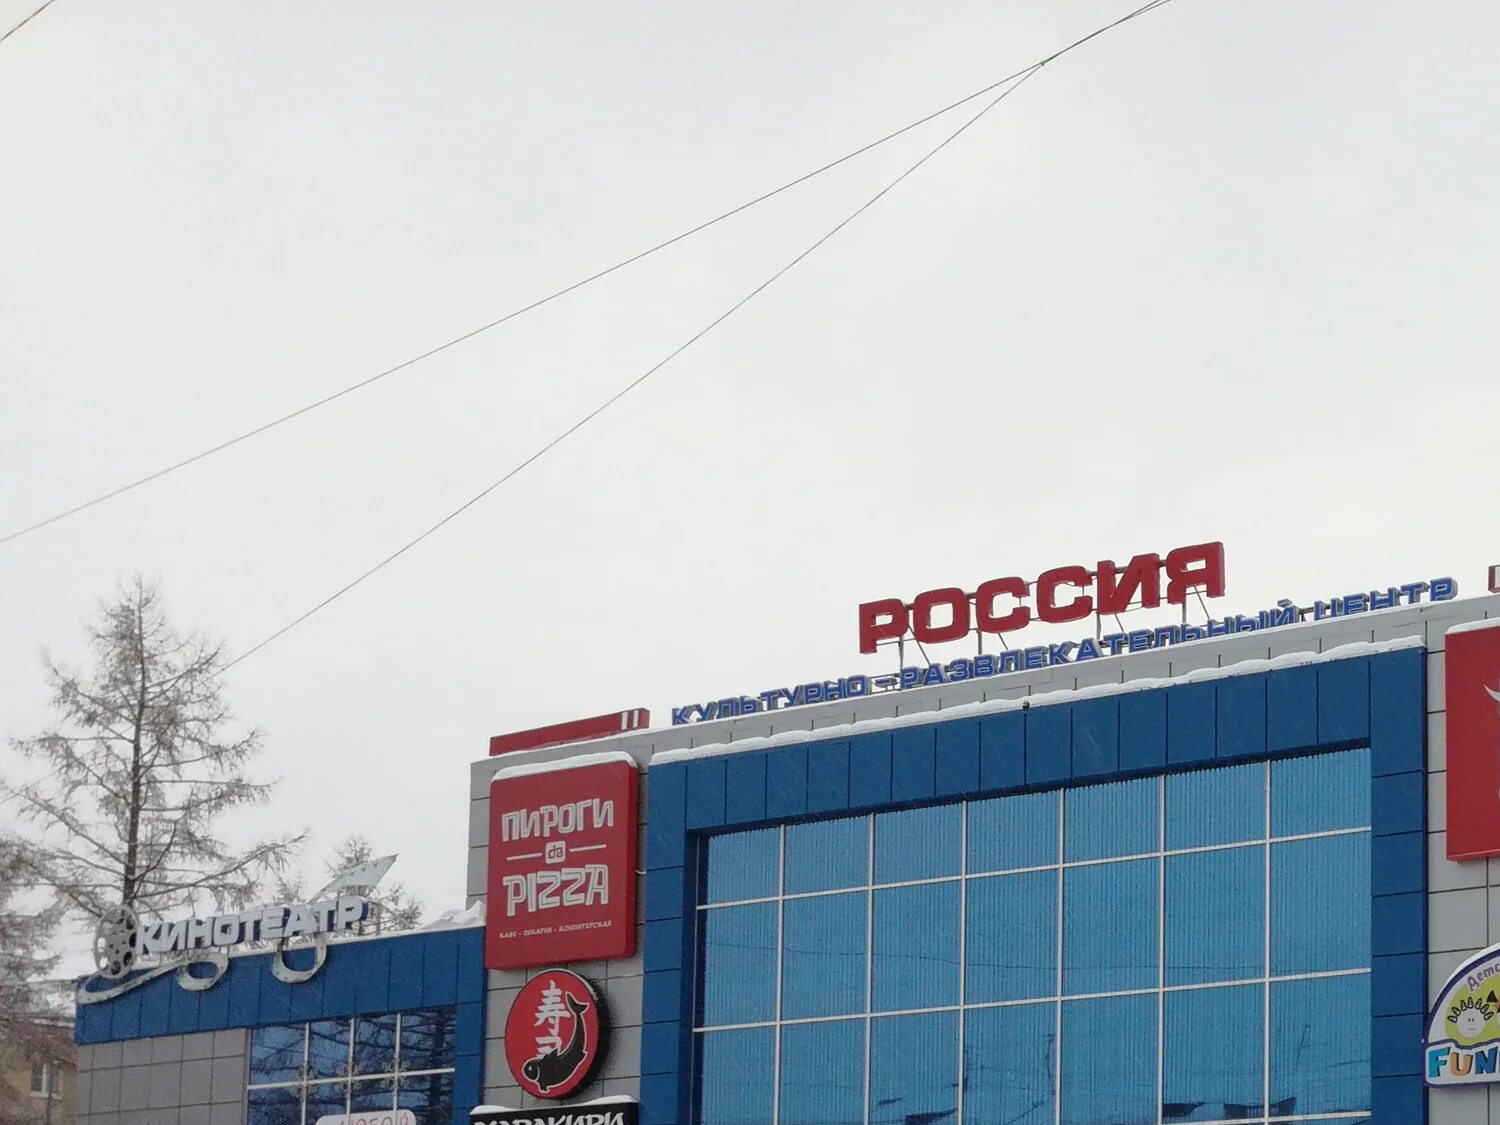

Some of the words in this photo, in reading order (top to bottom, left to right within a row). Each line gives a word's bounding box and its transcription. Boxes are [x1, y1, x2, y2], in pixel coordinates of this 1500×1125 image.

[858, 541, 1225, 655] РОССИЯ
[1314, 576, 1458, 620] ЦЕНТР
[501, 797, 615, 842] ПИРОГИ
[502, 863, 609, 917] PIZZA
[137, 895, 369, 955] КИНОТЕАТР
